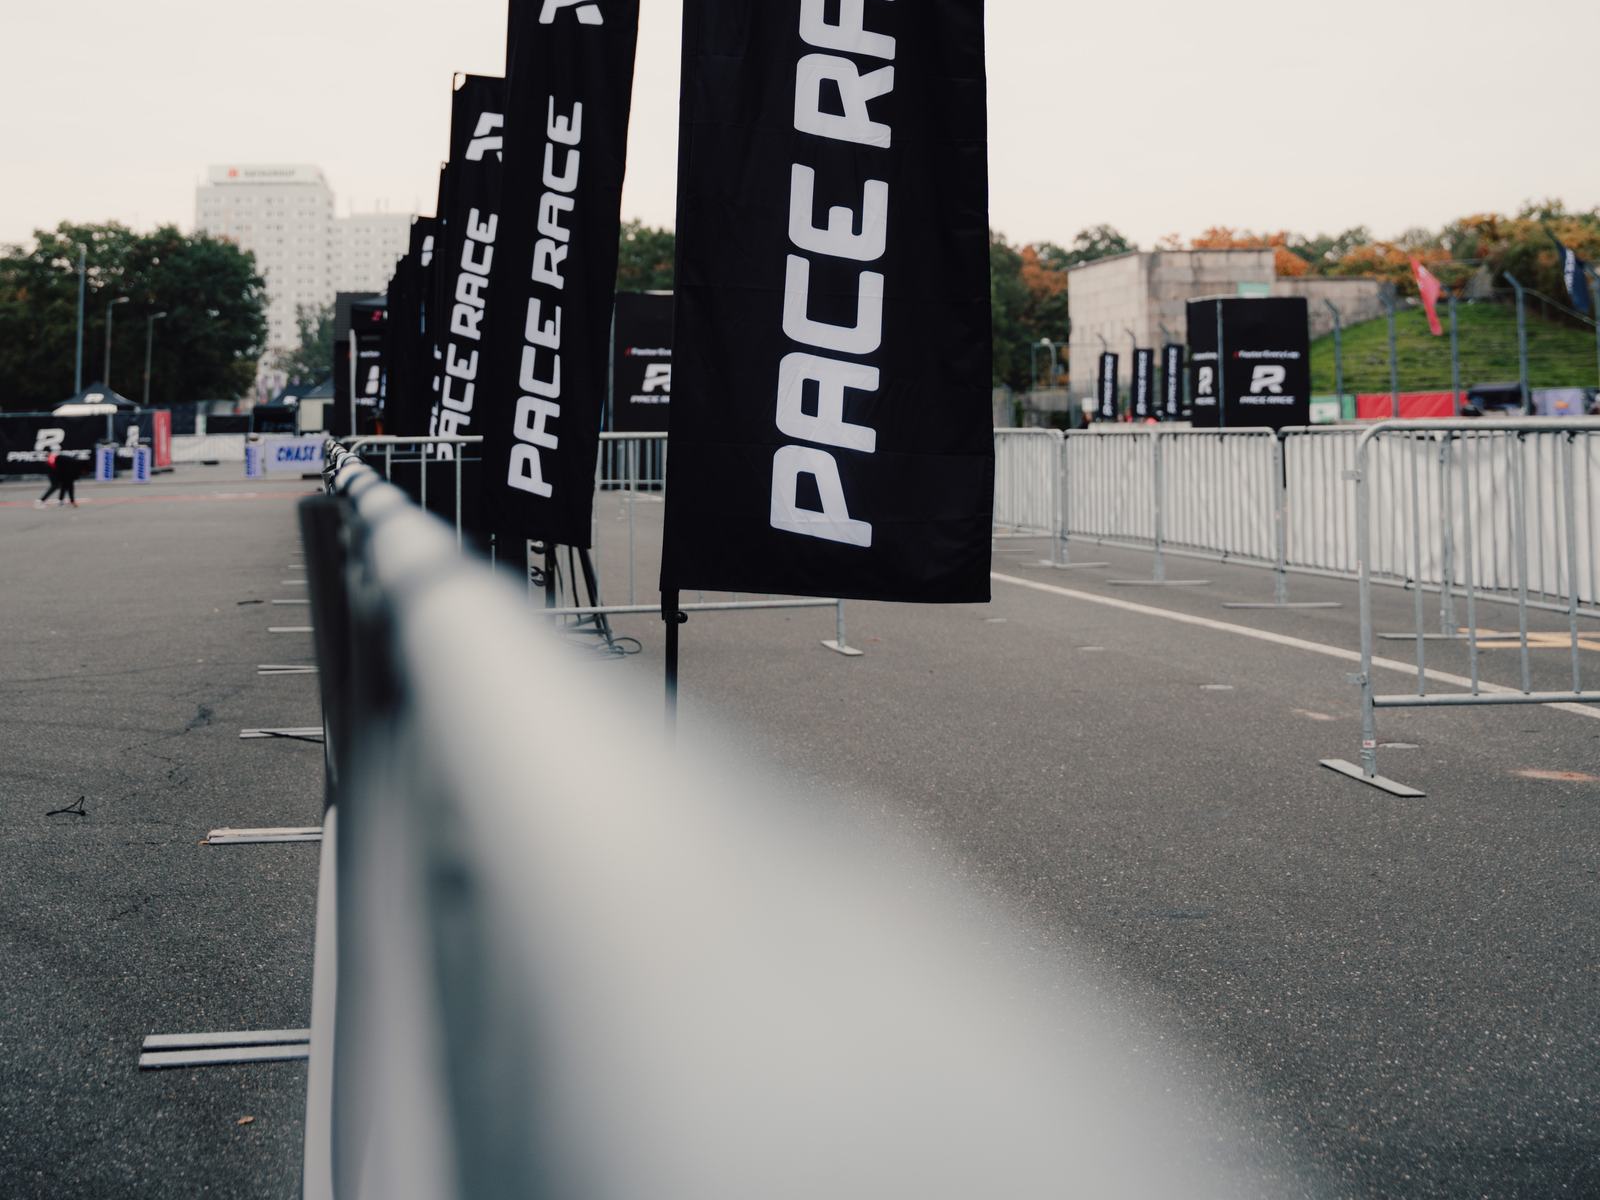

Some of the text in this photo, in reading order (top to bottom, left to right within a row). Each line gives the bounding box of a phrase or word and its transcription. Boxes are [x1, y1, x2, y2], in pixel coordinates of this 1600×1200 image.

[450, 207, 499, 341] RACE
[507, 95, 583, 498] PACE RACE
[769, 163, 889, 548] PACE
[1249, 365, 1286, 394] R
